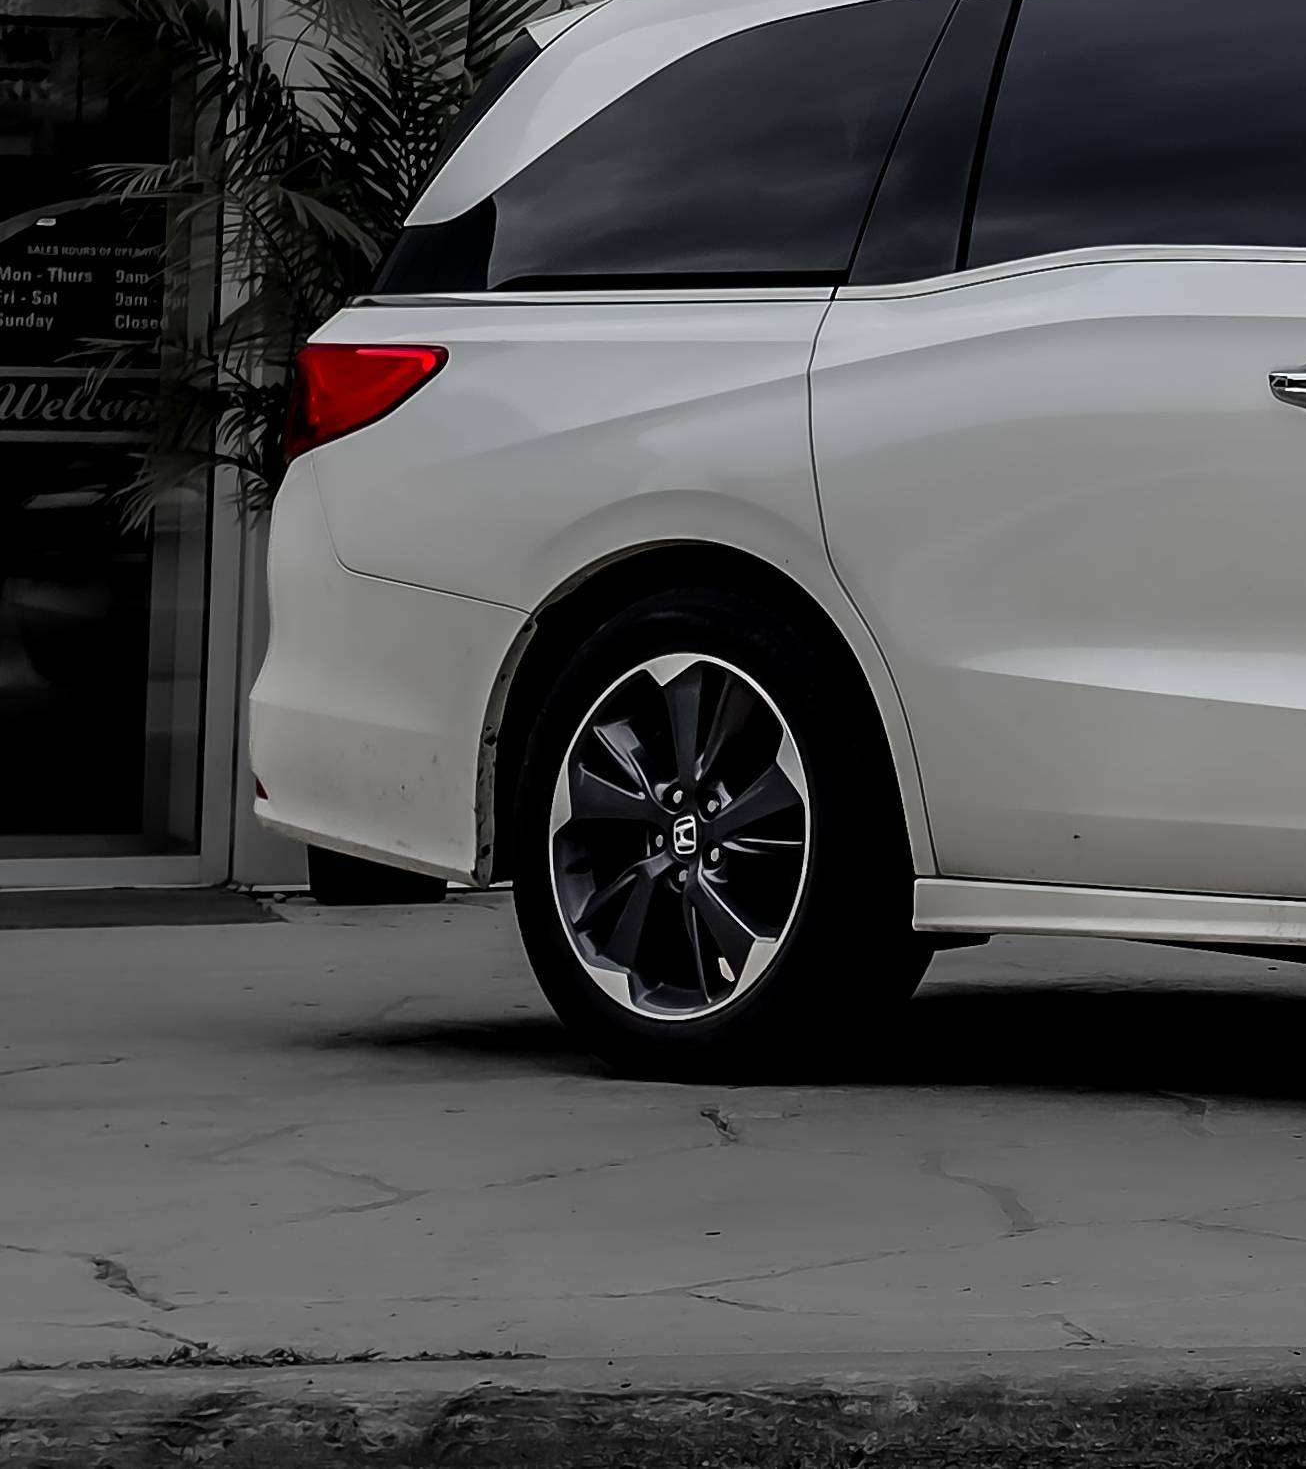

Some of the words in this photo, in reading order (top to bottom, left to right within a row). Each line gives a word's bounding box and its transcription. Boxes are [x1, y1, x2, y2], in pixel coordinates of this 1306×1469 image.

[47, 266, 93, 283] Thurs
[115, 268, 148, 284] 9am
[31, 289, 58, 306] Sat
[115, 291, 148, 307] 9am
[114, 314, 169, 331] Closed
